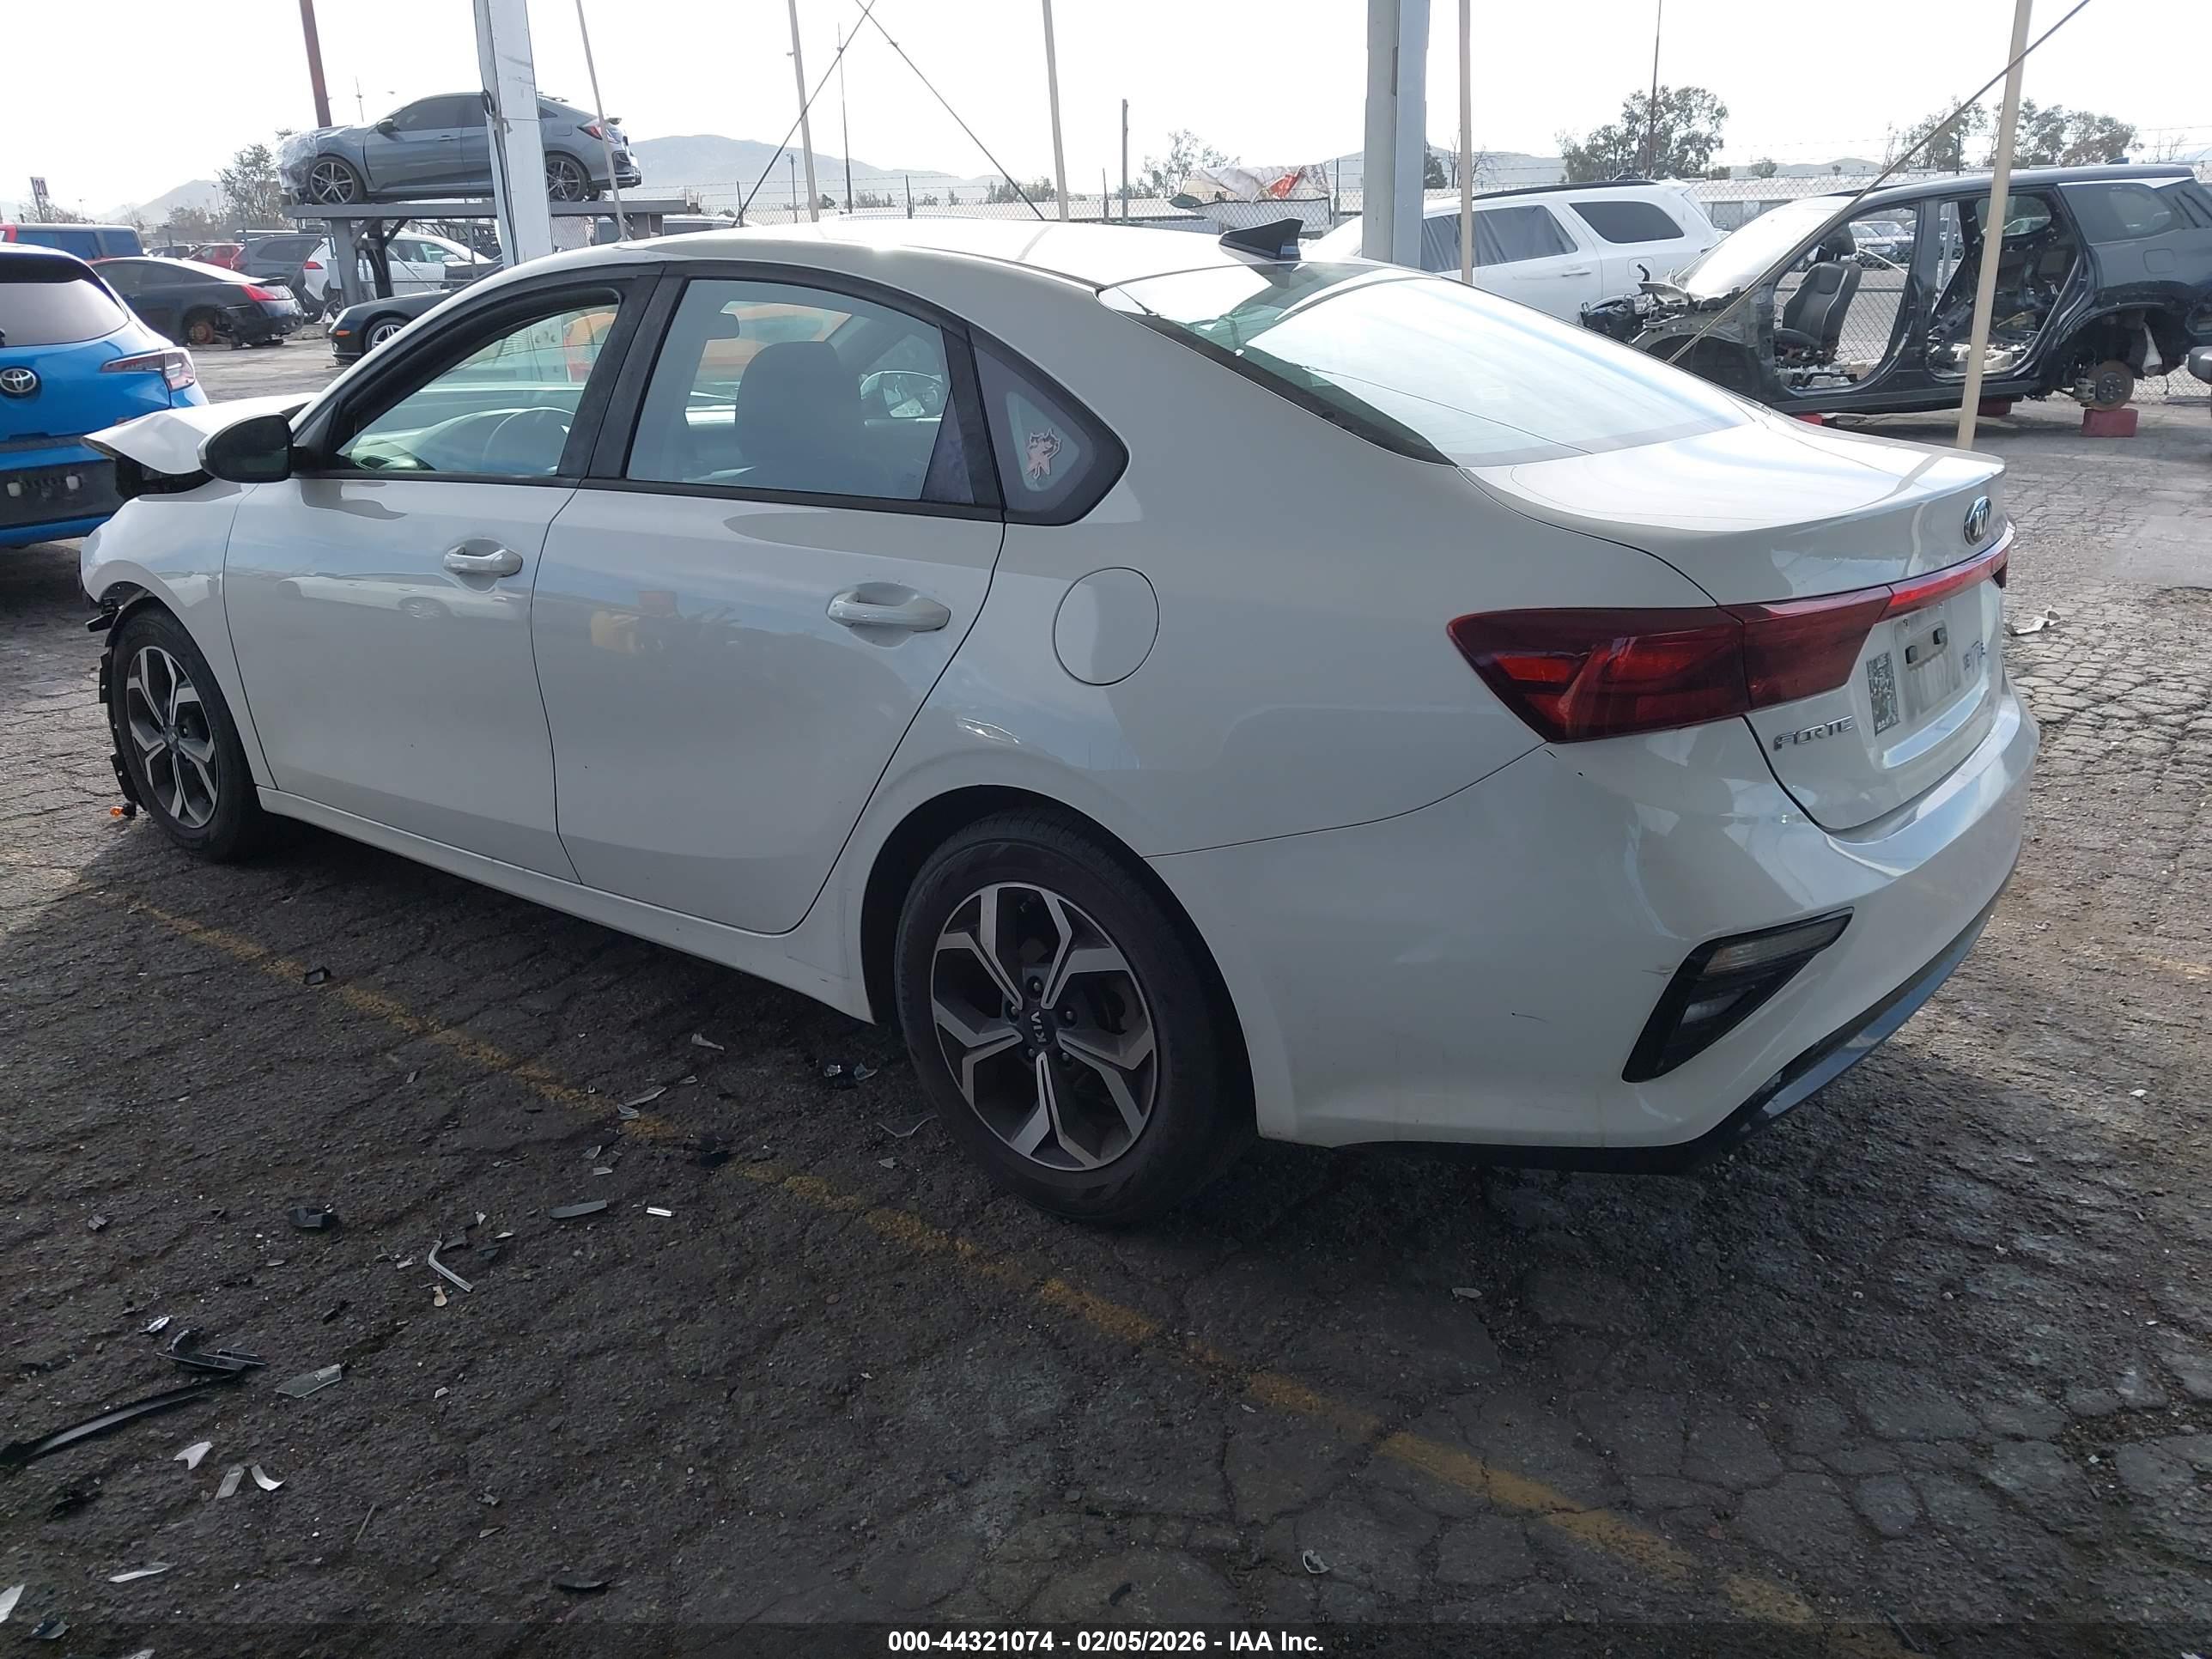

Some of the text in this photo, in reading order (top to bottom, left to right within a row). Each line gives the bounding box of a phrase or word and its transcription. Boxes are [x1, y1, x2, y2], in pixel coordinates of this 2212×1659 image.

[35, 179, 47, 196] 20
[1773, 714, 1854, 751] FORTE
[1030, 1011, 1047, 1042] KIA
